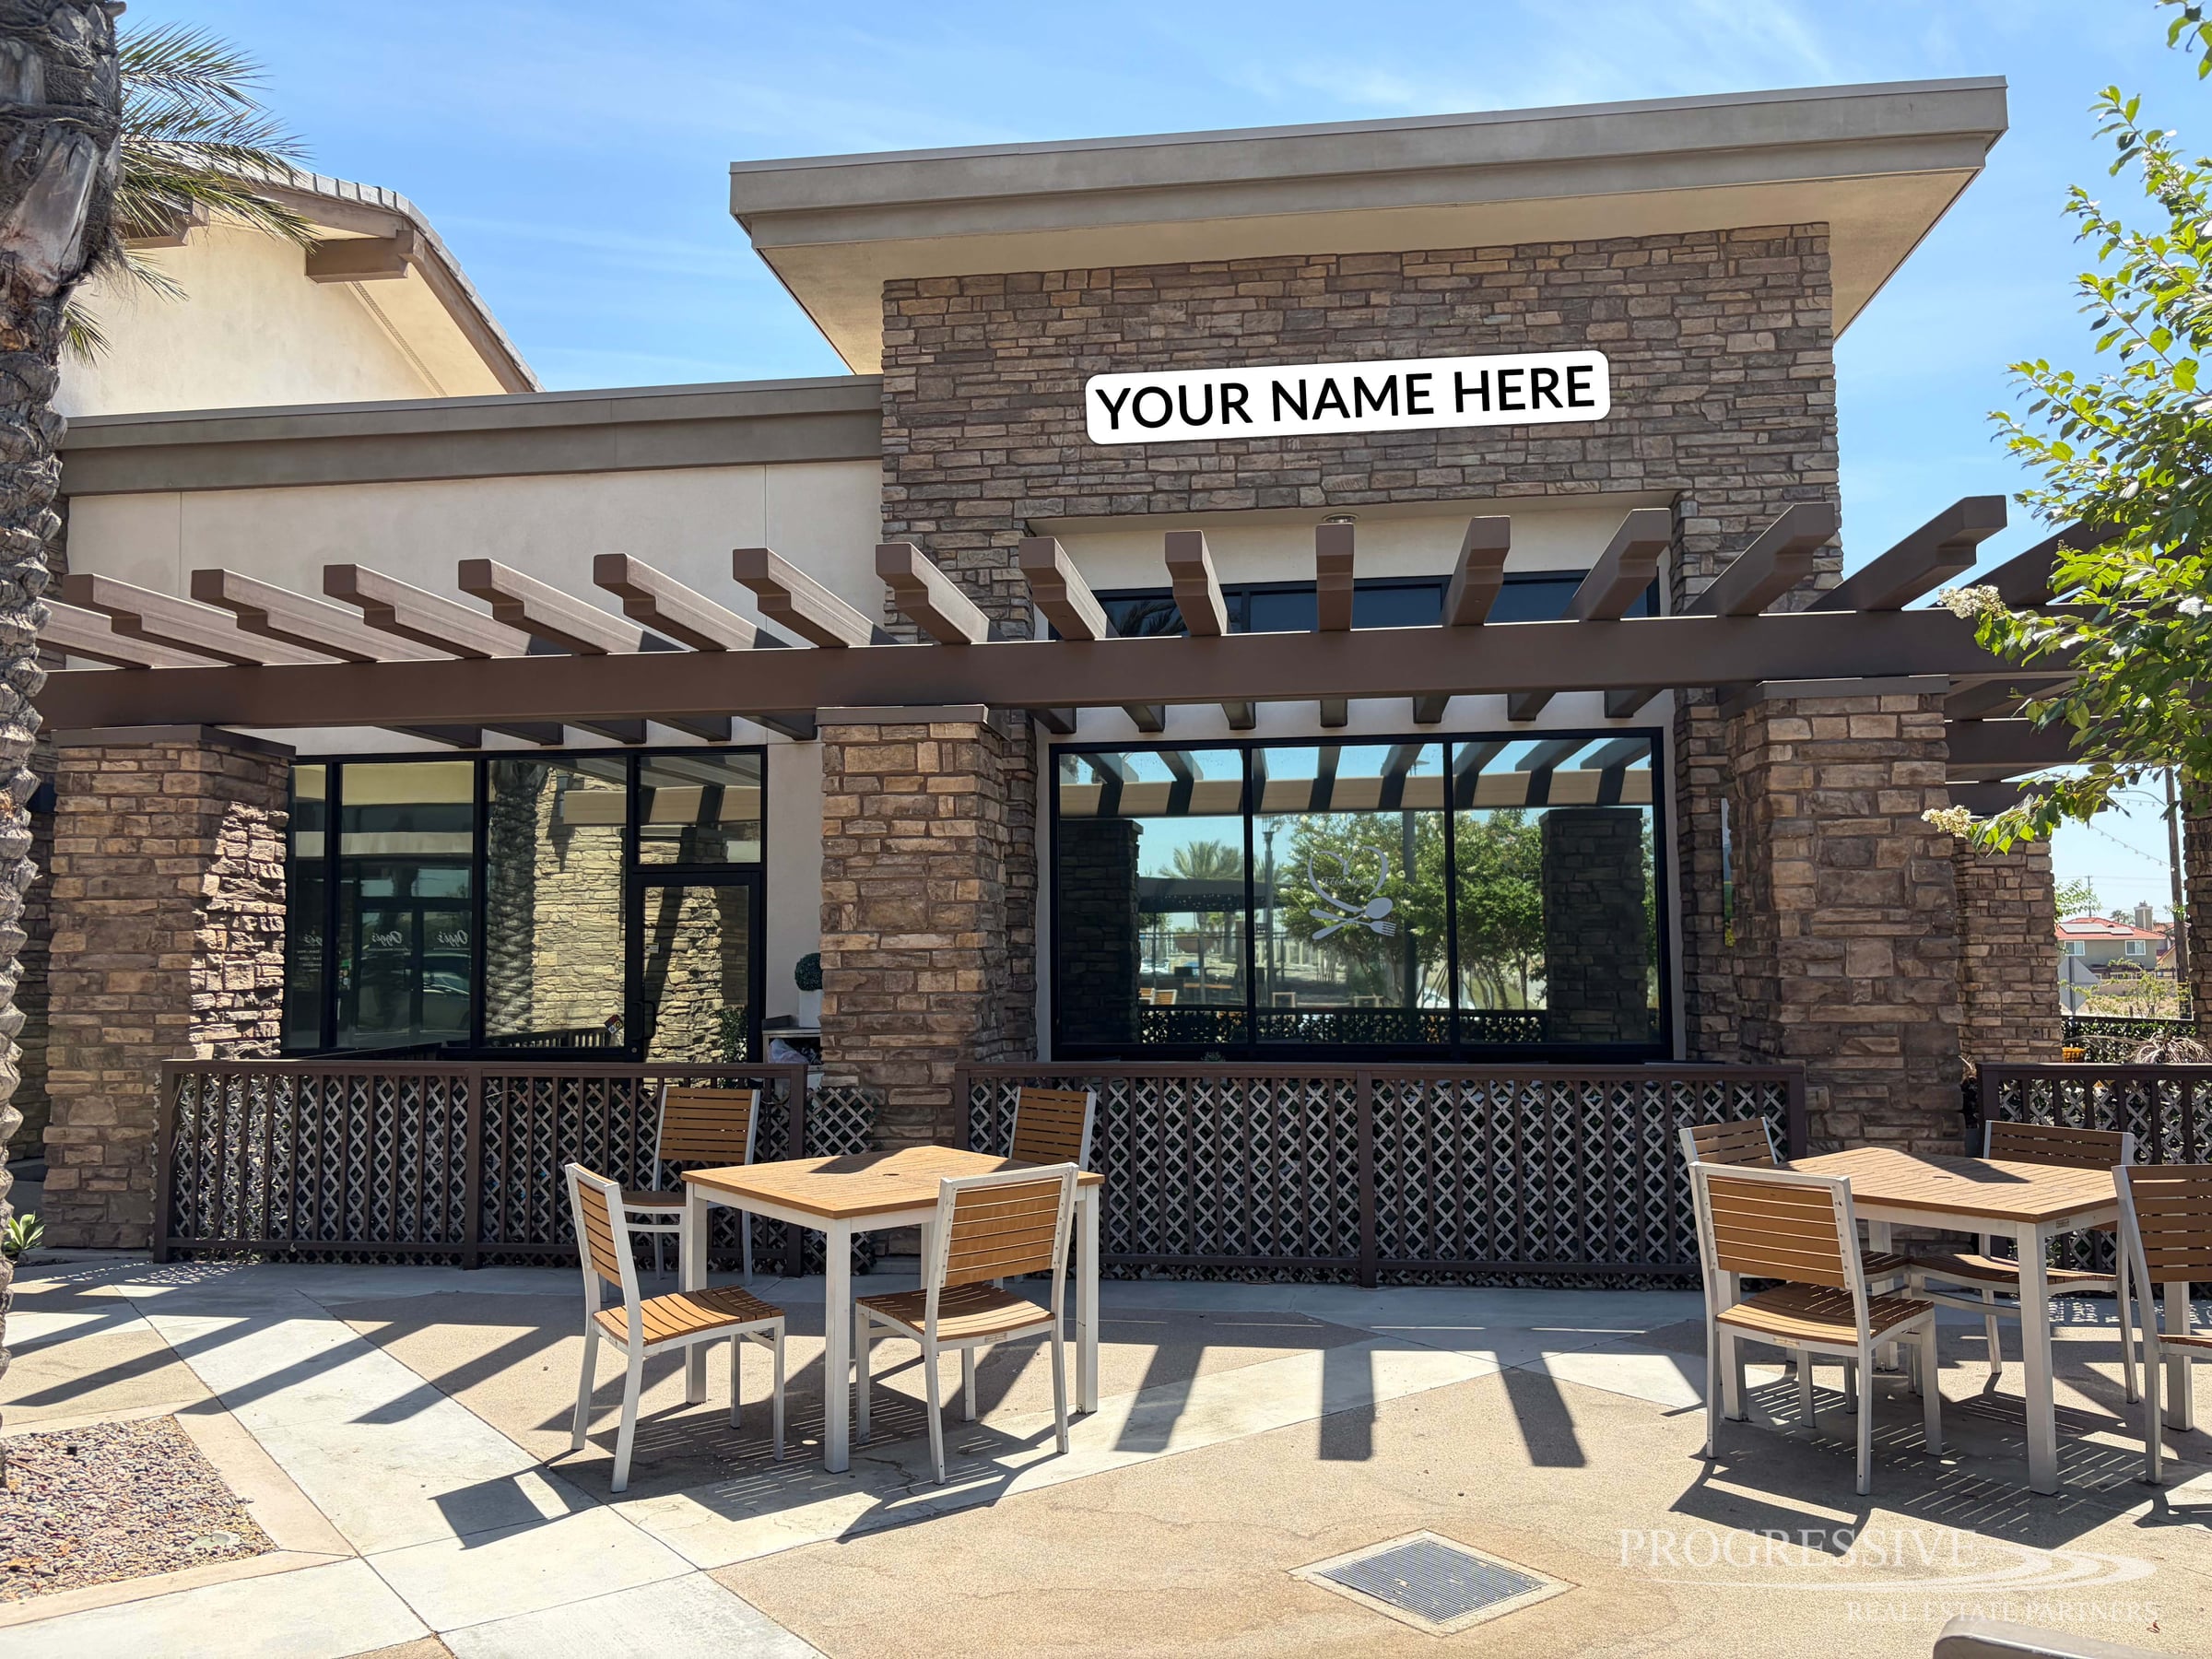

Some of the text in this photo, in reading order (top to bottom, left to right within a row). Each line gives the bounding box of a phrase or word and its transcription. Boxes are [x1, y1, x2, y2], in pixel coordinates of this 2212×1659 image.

[1095, 364, 1595, 430] YOUR NAME HERE
